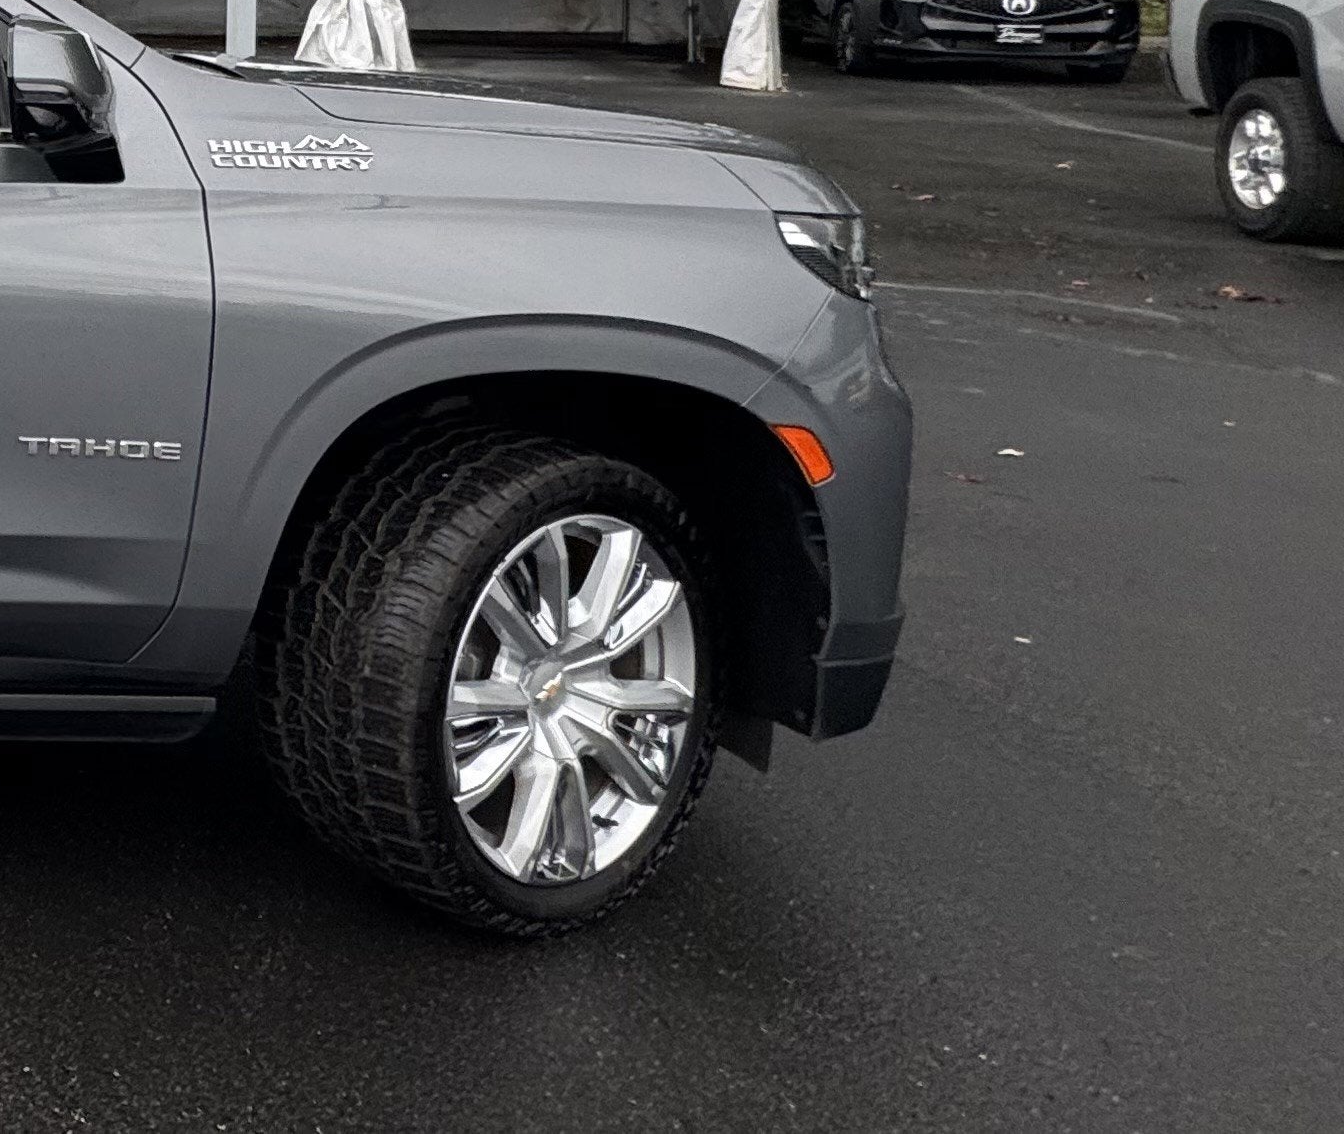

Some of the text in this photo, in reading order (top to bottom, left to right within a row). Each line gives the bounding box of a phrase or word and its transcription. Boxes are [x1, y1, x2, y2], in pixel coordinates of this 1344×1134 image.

[207, 139, 292, 154] HIGH
[211, 154, 375, 170] COUNTRY
[17, 435, 182, 461] TAHOE
